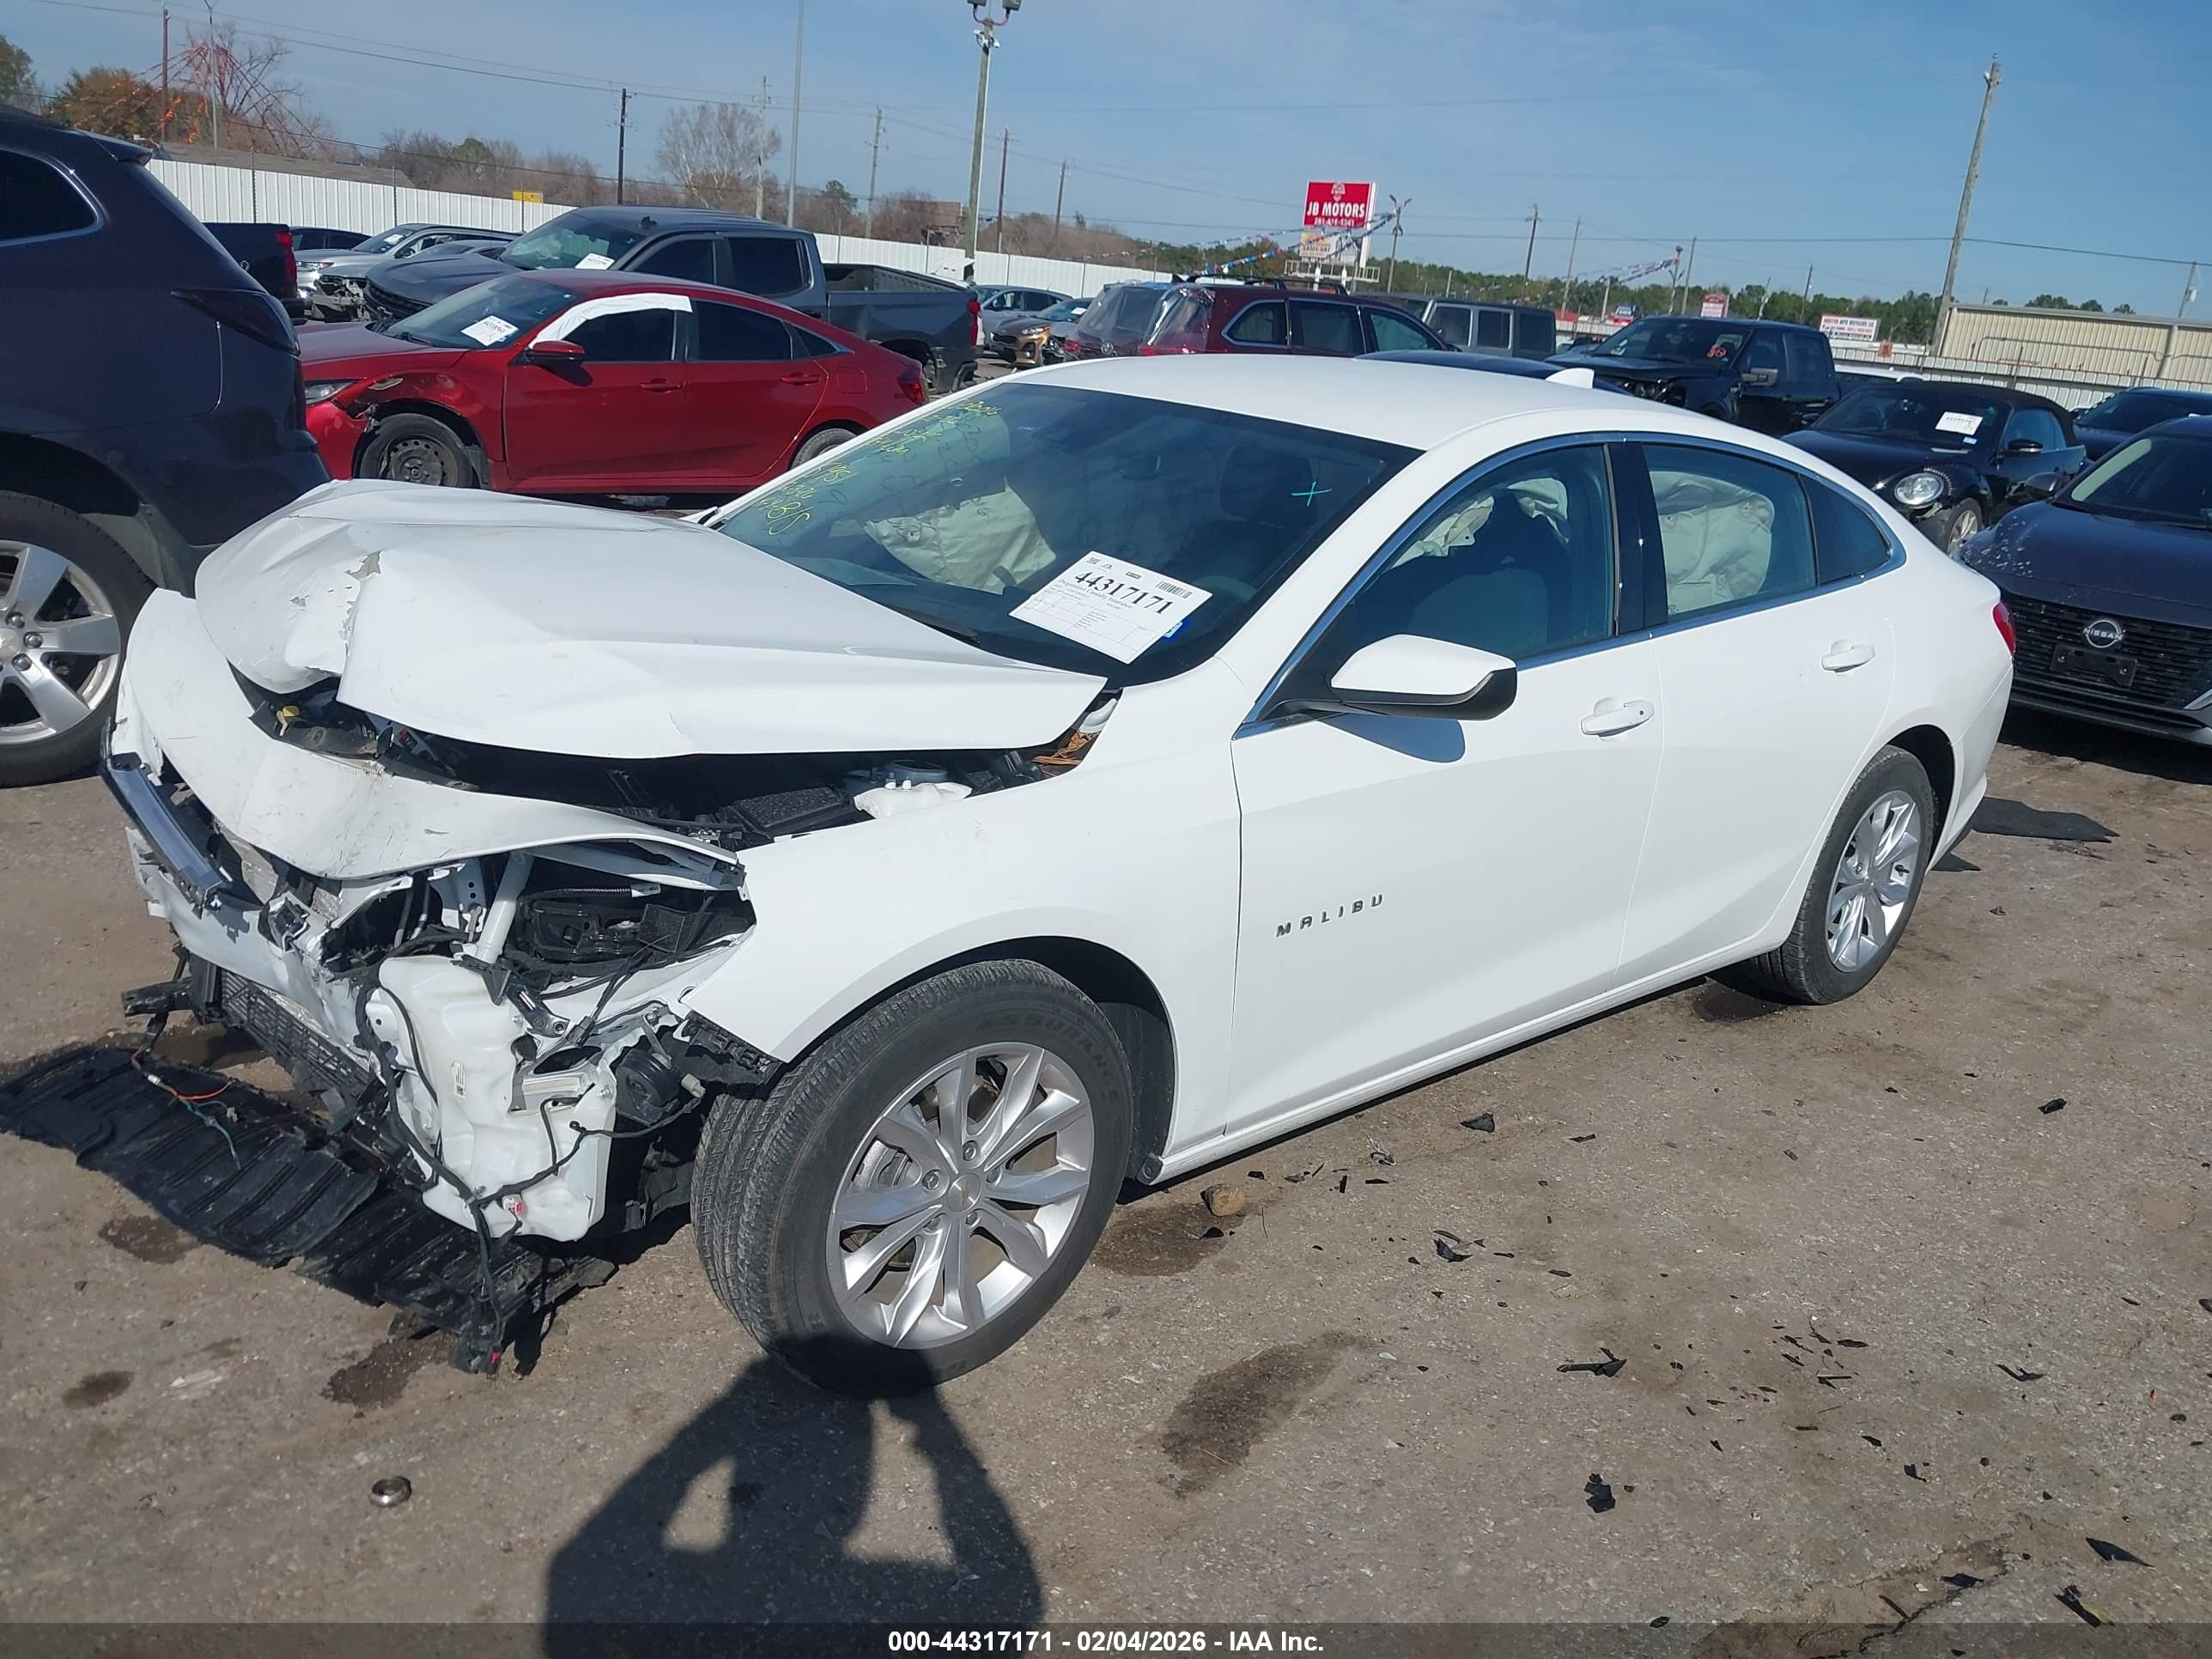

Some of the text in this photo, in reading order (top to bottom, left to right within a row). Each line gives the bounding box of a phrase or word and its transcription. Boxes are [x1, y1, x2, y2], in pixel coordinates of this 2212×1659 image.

[1322, 202, 1365, 218] MOTORS
[1075, 572, 1175, 614] 44317171
[2083, 627, 2124, 641] NISSAN
[1276, 894, 1383, 938] MALIBU
